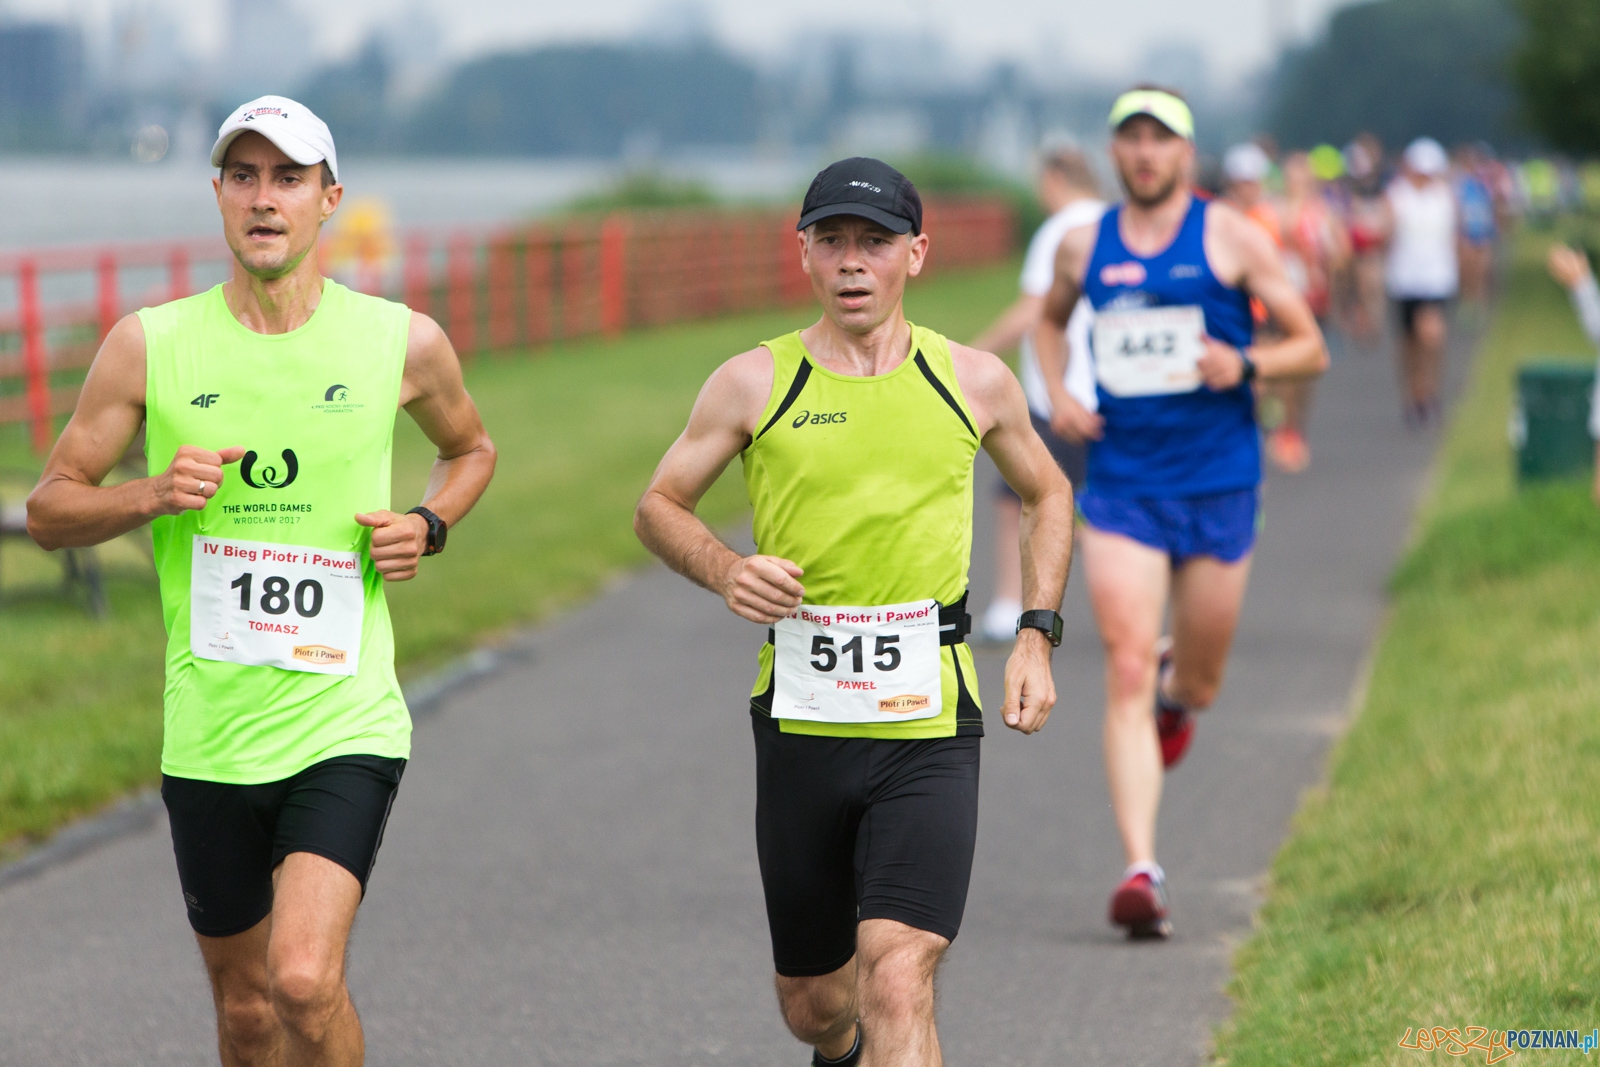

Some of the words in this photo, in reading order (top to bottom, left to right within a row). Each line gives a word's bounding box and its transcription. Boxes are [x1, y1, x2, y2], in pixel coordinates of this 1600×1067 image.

[190, 393, 220, 409] 4F
[222, 505, 241, 514] THE
[243, 503, 277, 513] WORLD
[280, 503, 312, 513] GAMES
[233, 516, 276, 525] WROCŁAW
[279, 516, 301, 524] 2017
[203, 543, 219, 555] IV
[223, 545, 257, 562] Bieg
[262, 549, 299, 564] Piotr
[303, 553, 307, 564] i
[231, 572, 324, 618] 180
[801, 611, 831, 627] Bieg
[836, 613, 872, 623] Piotr
[877, 612, 881, 622] i
[887, 606, 929, 622] Paweł
[248, 620, 299, 635] TOMASZ
[294, 648, 314, 657] Piotr
[810, 634, 901, 673] 515
[836, 680, 876, 690] PAWEŁ
[880, 700, 900, 708] Piotr
